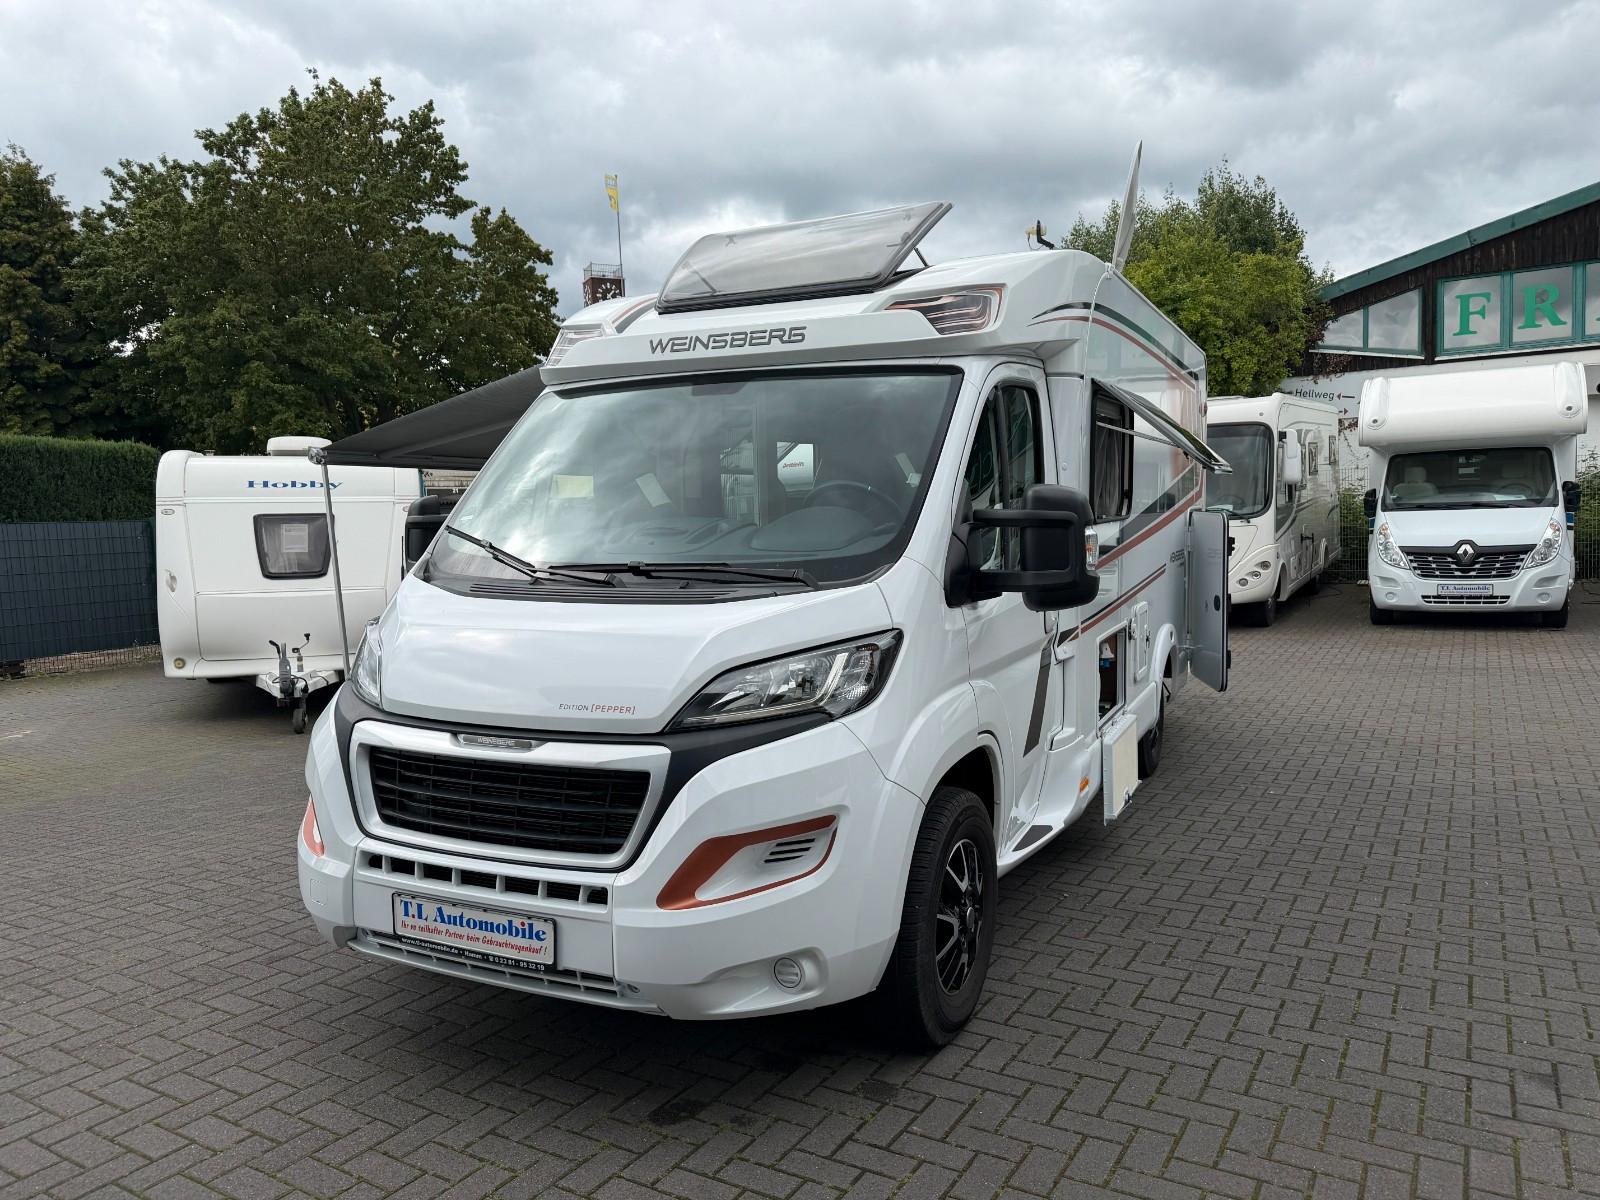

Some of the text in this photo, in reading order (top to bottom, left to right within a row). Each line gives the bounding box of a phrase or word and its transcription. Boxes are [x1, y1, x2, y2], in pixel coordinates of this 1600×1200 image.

[1453, 283, 1600, 337] FR
[649, 326, 807, 354] WEINSBERG
[1294, 388, 1335, 402] Hellweg
[247, 480, 343, 489] Hobby
[559, 703, 636, 715] EDITION [PEPPER]
[433, 906, 547, 942] Automobile
[444, 928, 465, 941] Partner
[466, 932, 480, 943] beim
